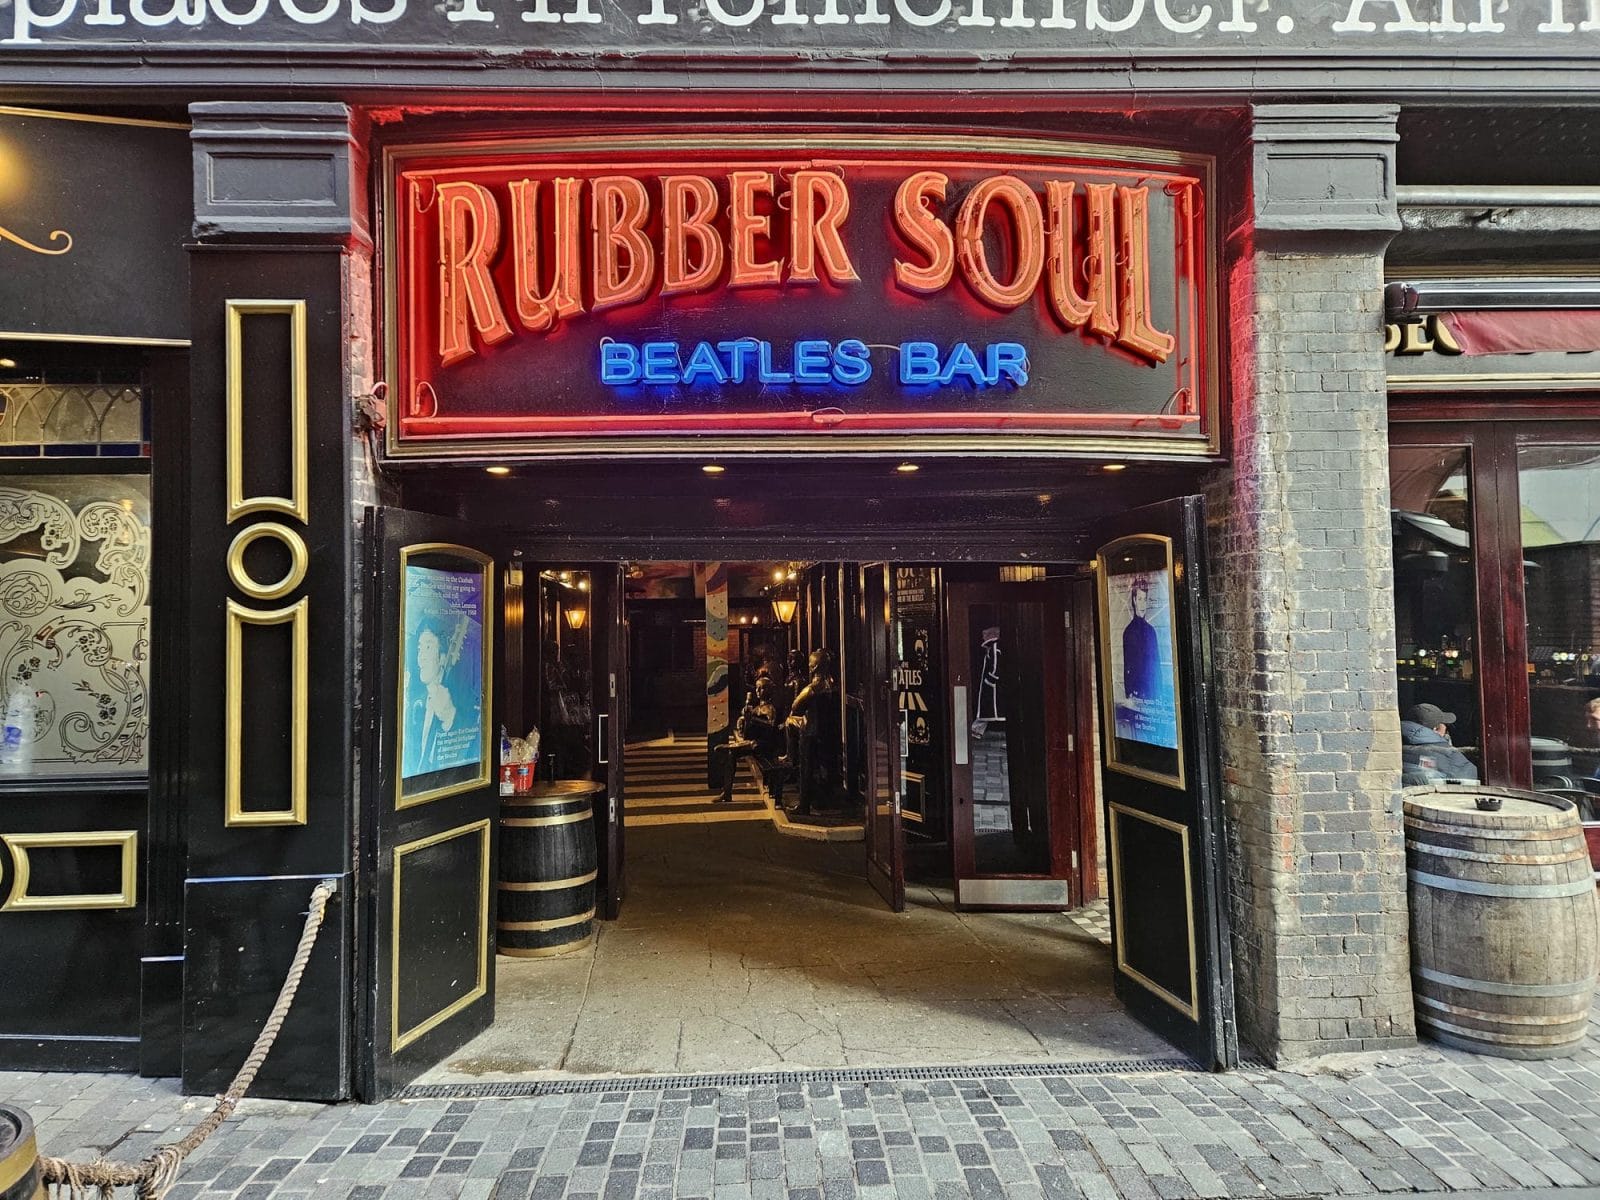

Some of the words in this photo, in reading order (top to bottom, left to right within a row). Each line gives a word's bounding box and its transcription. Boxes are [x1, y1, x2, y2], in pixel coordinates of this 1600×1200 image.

[437, 171, 862, 367] RUBBER
[895, 171, 1176, 364] SOUL
[601, 338, 873, 386] BEATLES
[899, 341, 1029, 387] BAR
[898, 665, 922, 690] ATLES
